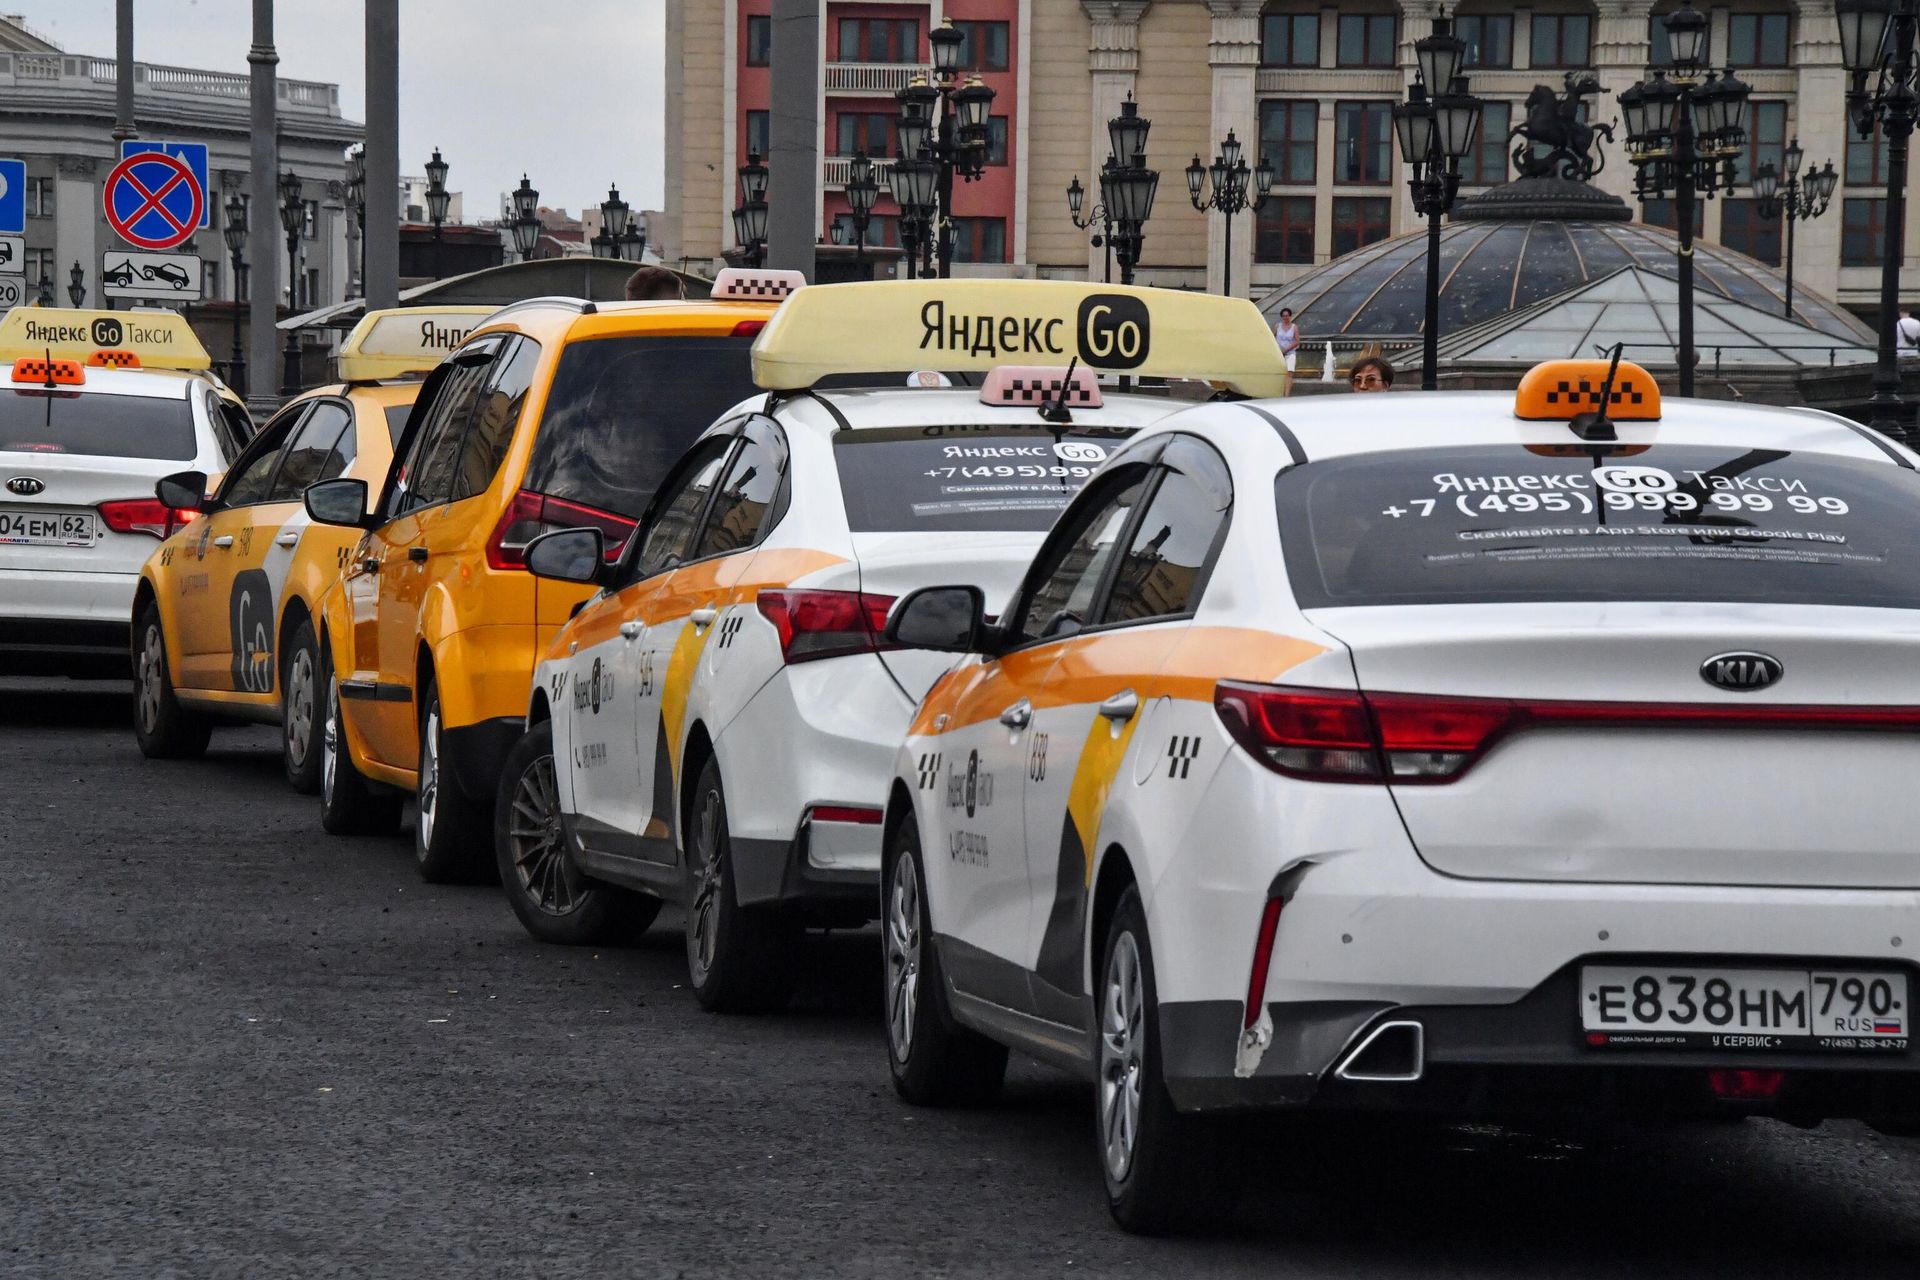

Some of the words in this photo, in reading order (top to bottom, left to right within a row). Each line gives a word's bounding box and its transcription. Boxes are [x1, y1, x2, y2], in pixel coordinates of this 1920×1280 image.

[26, 321, 87, 343] Яндекс
[95, 321, 119, 344] Go
[126, 323, 173, 344] Такси
[919, 300, 1064, 358] Яндекс
[1085, 303, 1142, 360] Go
[943, 446, 1048, 458] Яндекс
[1059, 444, 1101, 460] Go
[12, 481, 39, 492] KIA
[946, 484, 1028, 493] Скачивайте
[1432, 473, 1590, 493] Яндекс
[1602, 469, 1667, 489] Go
[1683, 470, 1809, 493] Такси
[1382, 499, 1436, 518] +7
[1456, 491, 1593, 517] (495)
[1603, 492, 1698, 511] 999
[1709, 493, 1774, 512] 99
[1786, 495, 1850, 515] 99
[63, 517, 84, 533] 62
[1459, 527, 1575, 540] Скачивайте
[1595, 526, 1634, 535] App
[1637, 526, 1689, 535] Store
[1693, 528, 1730, 536] или
[1734, 527, 1803, 538] Google
[1807, 531, 1846, 543] Play
[1717, 661, 1769, 683] KIA
[1814, 977, 1892, 1016] 790
[1835, 1017, 1872, 1032] RUS
[1723, 1035, 1771, 1047] СЕРВИС
